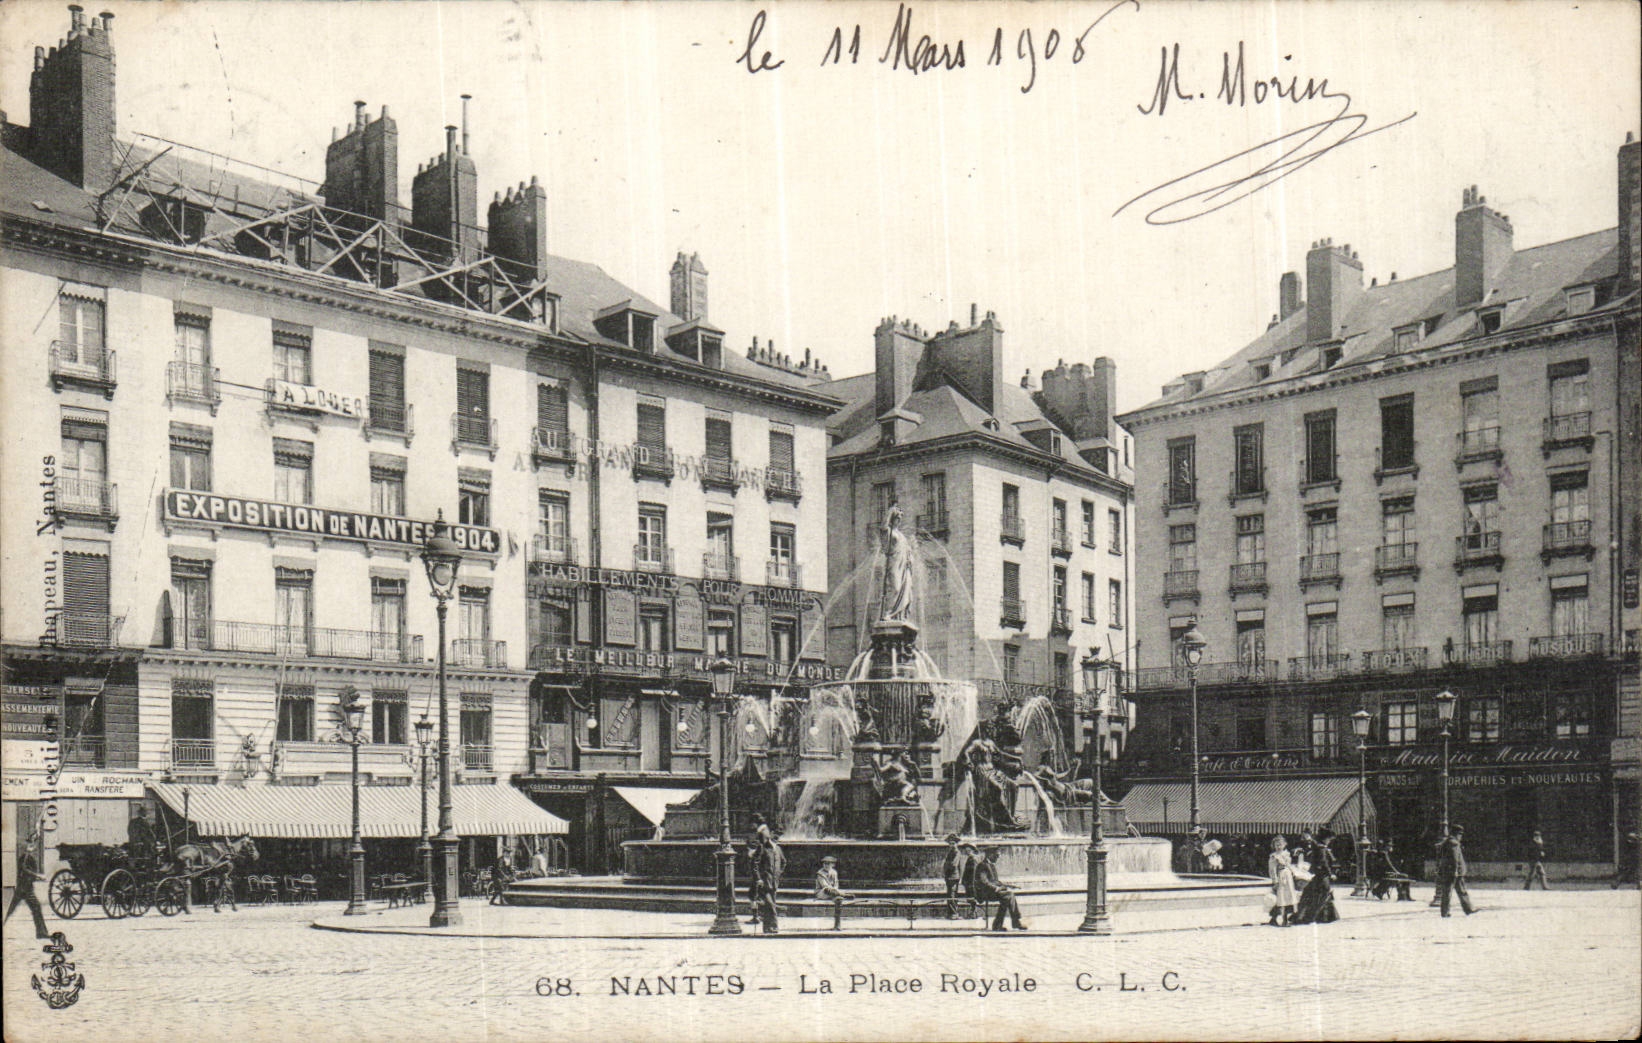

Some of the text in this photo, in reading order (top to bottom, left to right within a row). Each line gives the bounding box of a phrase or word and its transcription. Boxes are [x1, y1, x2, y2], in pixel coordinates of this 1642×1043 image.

[737, 10, 784, 73] le
[821, 24, 860, 66] 11
[879, 3, 966, 75] Mars
[283, 386, 295, 402] A
[176, 493, 495, 552] EXPOSITION DE NANTES 1904
[541, 563, 680, 591] HABILLEMENTS
[703, 579, 740, 597] POUR
[556, 647, 575, 662] LE
[694, 656, 750, 673] MAHE
[766, 662, 783, 676] DU
[1388, 748, 1474, 766] Mauice
[1447, 774, 1507, 787] DRAPERIES
